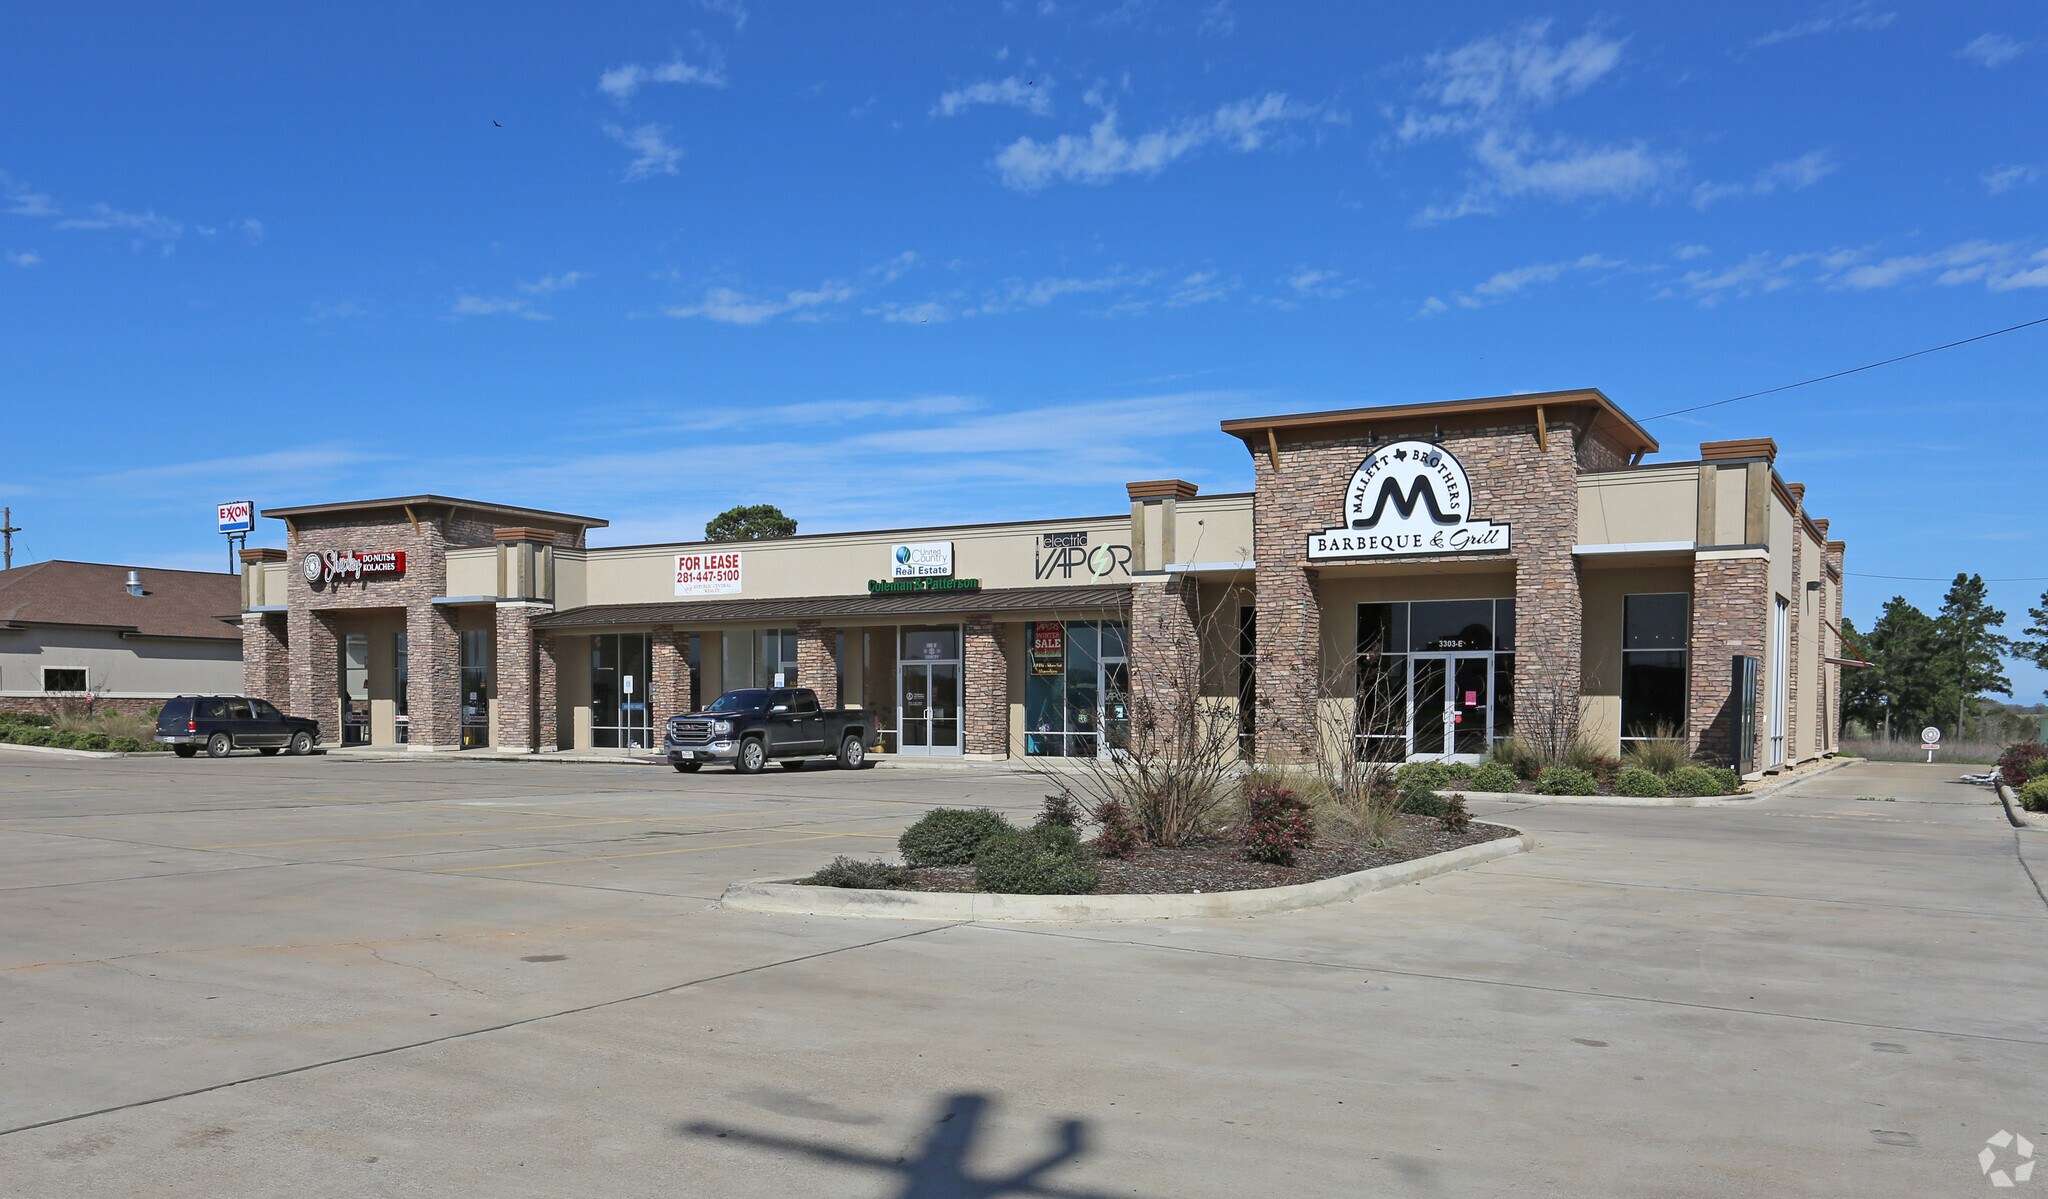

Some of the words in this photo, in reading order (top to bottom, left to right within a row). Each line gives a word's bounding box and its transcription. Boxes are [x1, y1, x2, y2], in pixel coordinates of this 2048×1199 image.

[1353, 454, 1389, 514] MALLETT
[1412, 449, 1461, 510] BROTHERS
[220, 505, 248, 522] EXXON
[1043, 532, 1088, 547] electric
[1318, 534, 1423, 552] BARBEQUE
[1429, 530, 1445, 548] &
[1449, 528, 1500, 551] Grill
[911, 548, 948, 563] Country
[920, 547, 942, 557] United
[323, 549, 362, 583] Shipley
[362, 562, 396, 572] KOLACHES
[679, 556, 701, 571] FOR
[704, 554, 739, 570] LEASE
[1036, 540, 1133, 582] VAPOR
[895, 566, 916, 576] Real
[918, 565, 948, 576] Estate
[867, 579, 914, 593] Coleman
[914, 577, 924, 591] &
[925, 577, 978, 590] Patterson
[1035, 639, 1061, 648] SALE
[1438, 640, 1463, 648] 3303-E
